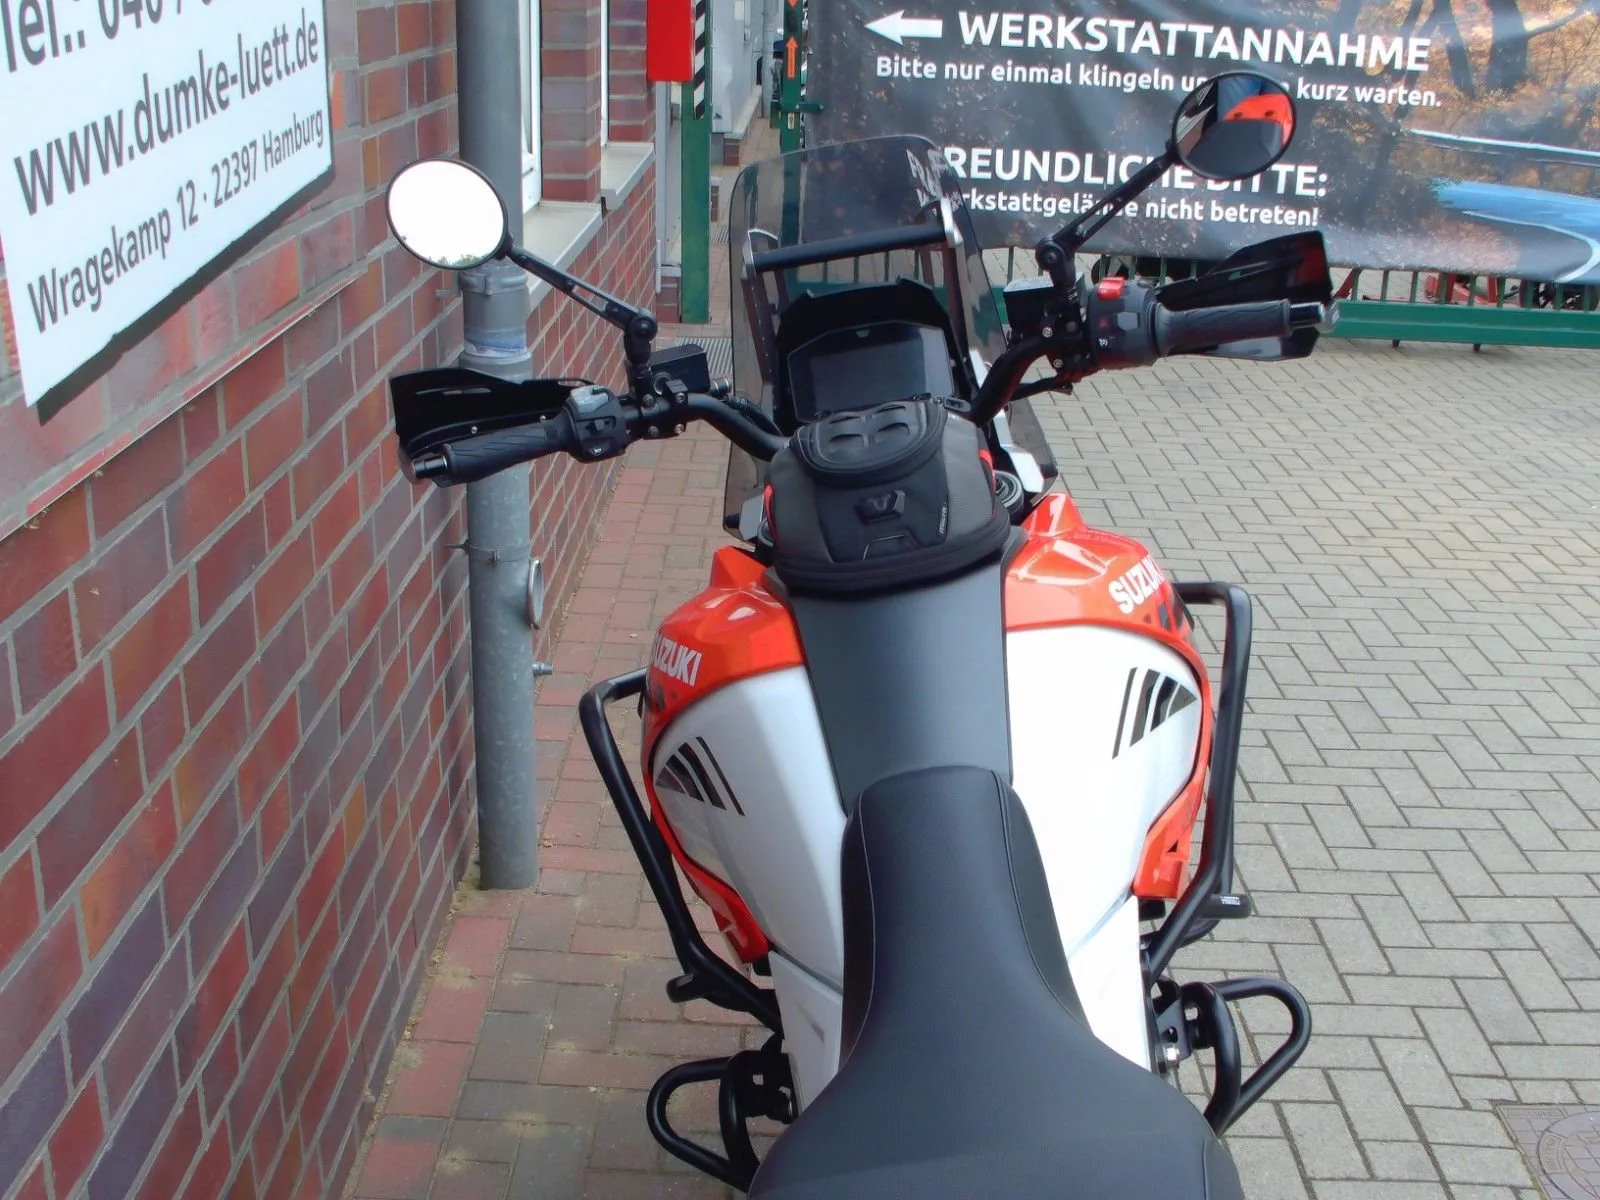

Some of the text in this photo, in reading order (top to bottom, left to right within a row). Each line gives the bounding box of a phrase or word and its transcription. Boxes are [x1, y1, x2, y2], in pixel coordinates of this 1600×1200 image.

[958, 10, 1431, 72] WERKSTATTANNAHME
[876, 55, 937, 79] Bitte
[944, 62, 985, 81] nur
[991, 59, 1072, 85] einmal
[1079, 63, 1174, 93] klingeln
[1296, 78, 1348, 101] kurz
[1354, 84, 1442, 108] warten.
[13, 7, 319, 216] www.dumke-luett.de
[930, 146, 1195, 190] REUNDLICE
[27, 207, 172, 333] Wragekamp
[176, 180, 199, 231] 12
[211, 139, 258, 209] 22397
[262, 109, 324, 172] Hamburg
[1145, 197, 1204, 221] nicht
[1210, 199, 1319, 227] betreten!
